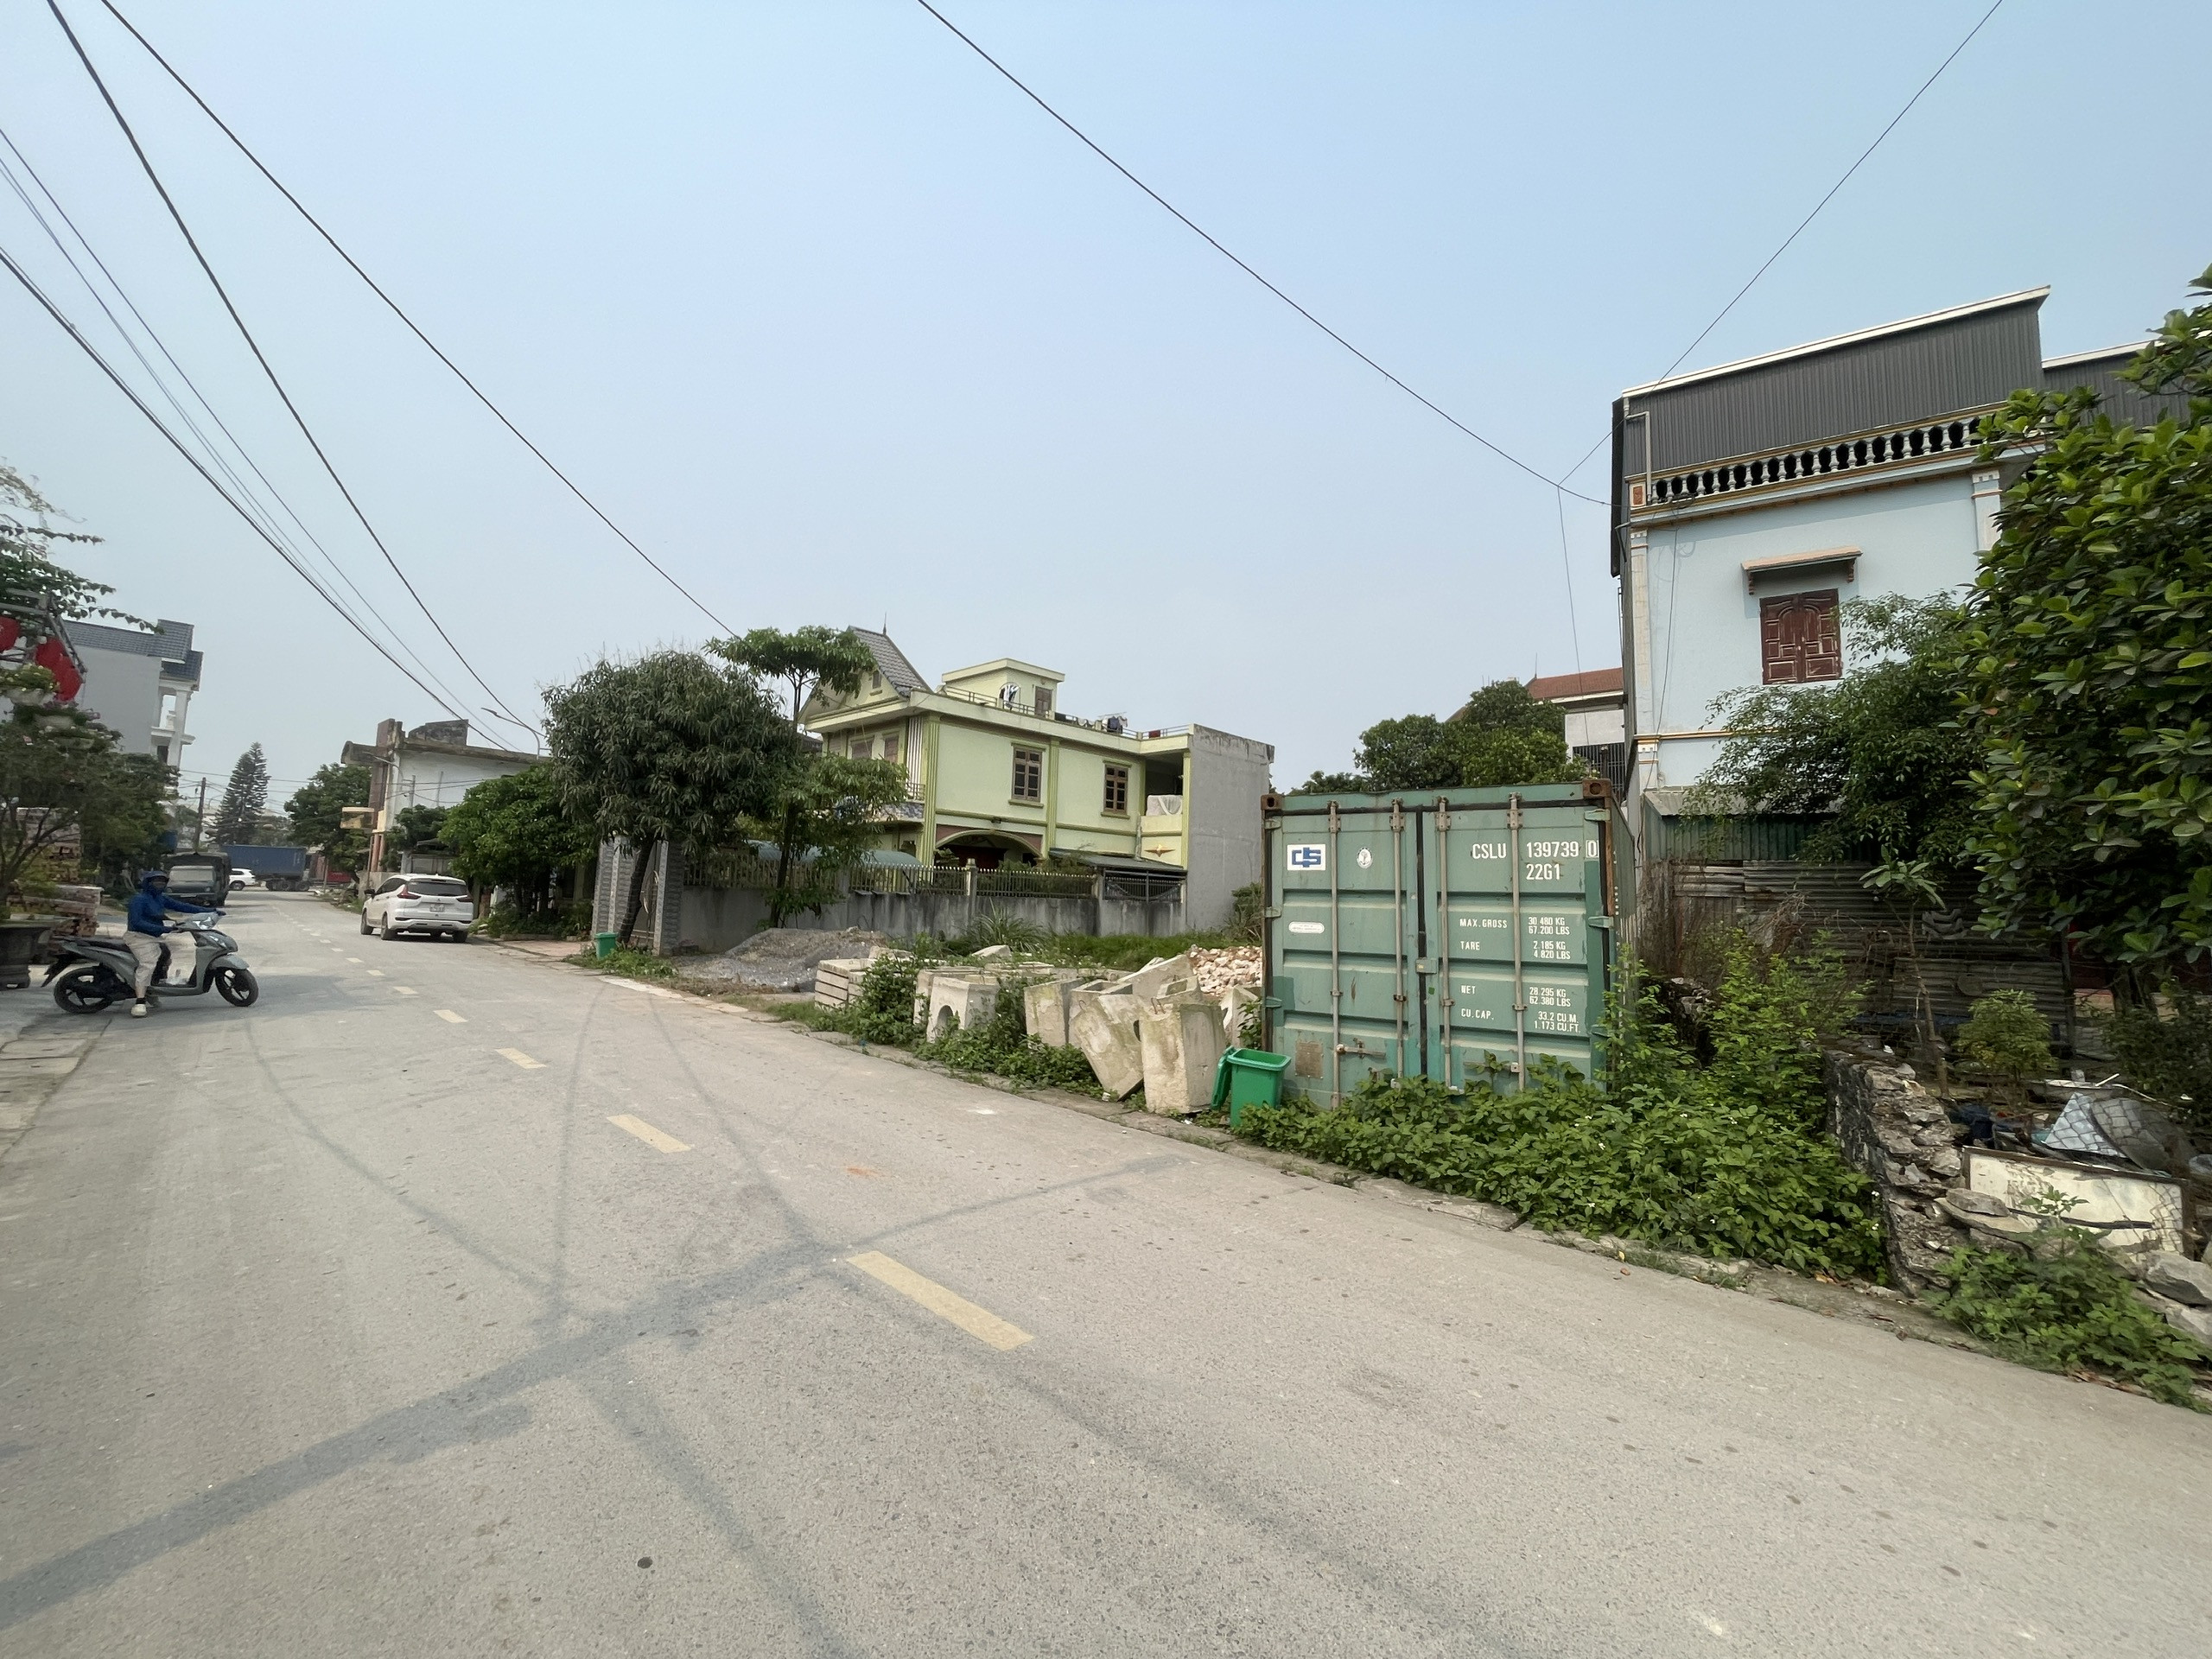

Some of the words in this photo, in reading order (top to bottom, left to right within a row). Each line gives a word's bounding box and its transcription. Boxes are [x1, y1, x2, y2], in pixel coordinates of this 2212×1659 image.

[1472, 843, 1507, 859] CSLU
[1526, 842, 1579, 858] 139739
[1526, 863, 1560, 880] 22G1
[1459, 918, 1508, 929] MAX.GROSS
[1555, 917, 1565, 925] KG
[1555, 926, 1570, 935] LBS
[1460, 941, 1480, 950] TARE
[1555, 941, 1566, 950] KG
[1556, 950, 1571, 959] LBS
[1556, 988, 1566, 998] KG
[1556, 997, 1571, 1007] LBS
[1538, 1011, 1554, 1020] 33.2
